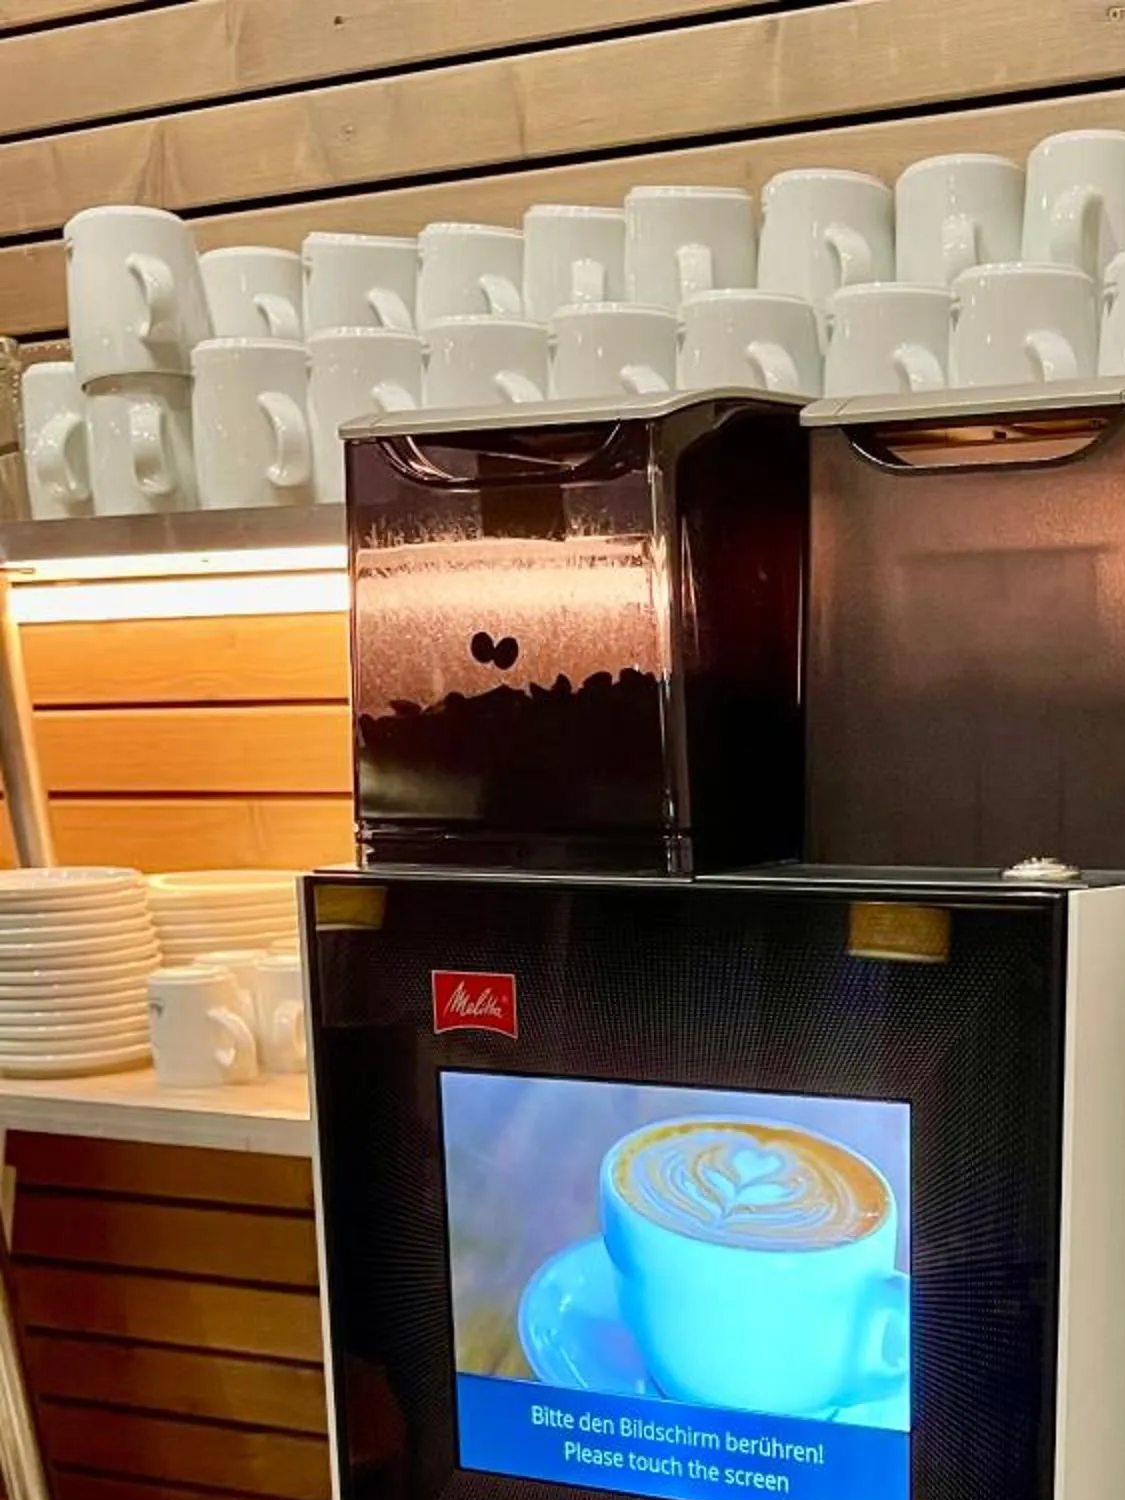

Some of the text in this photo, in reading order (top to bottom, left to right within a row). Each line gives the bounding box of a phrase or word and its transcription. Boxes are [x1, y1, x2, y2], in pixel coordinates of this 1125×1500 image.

[442, 979, 503, 1019] Melitta
[531, 1405, 825, 1465] Bitte den Bildschirm berühren!
[564, 1441, 790, 1494] Please touch the screen
